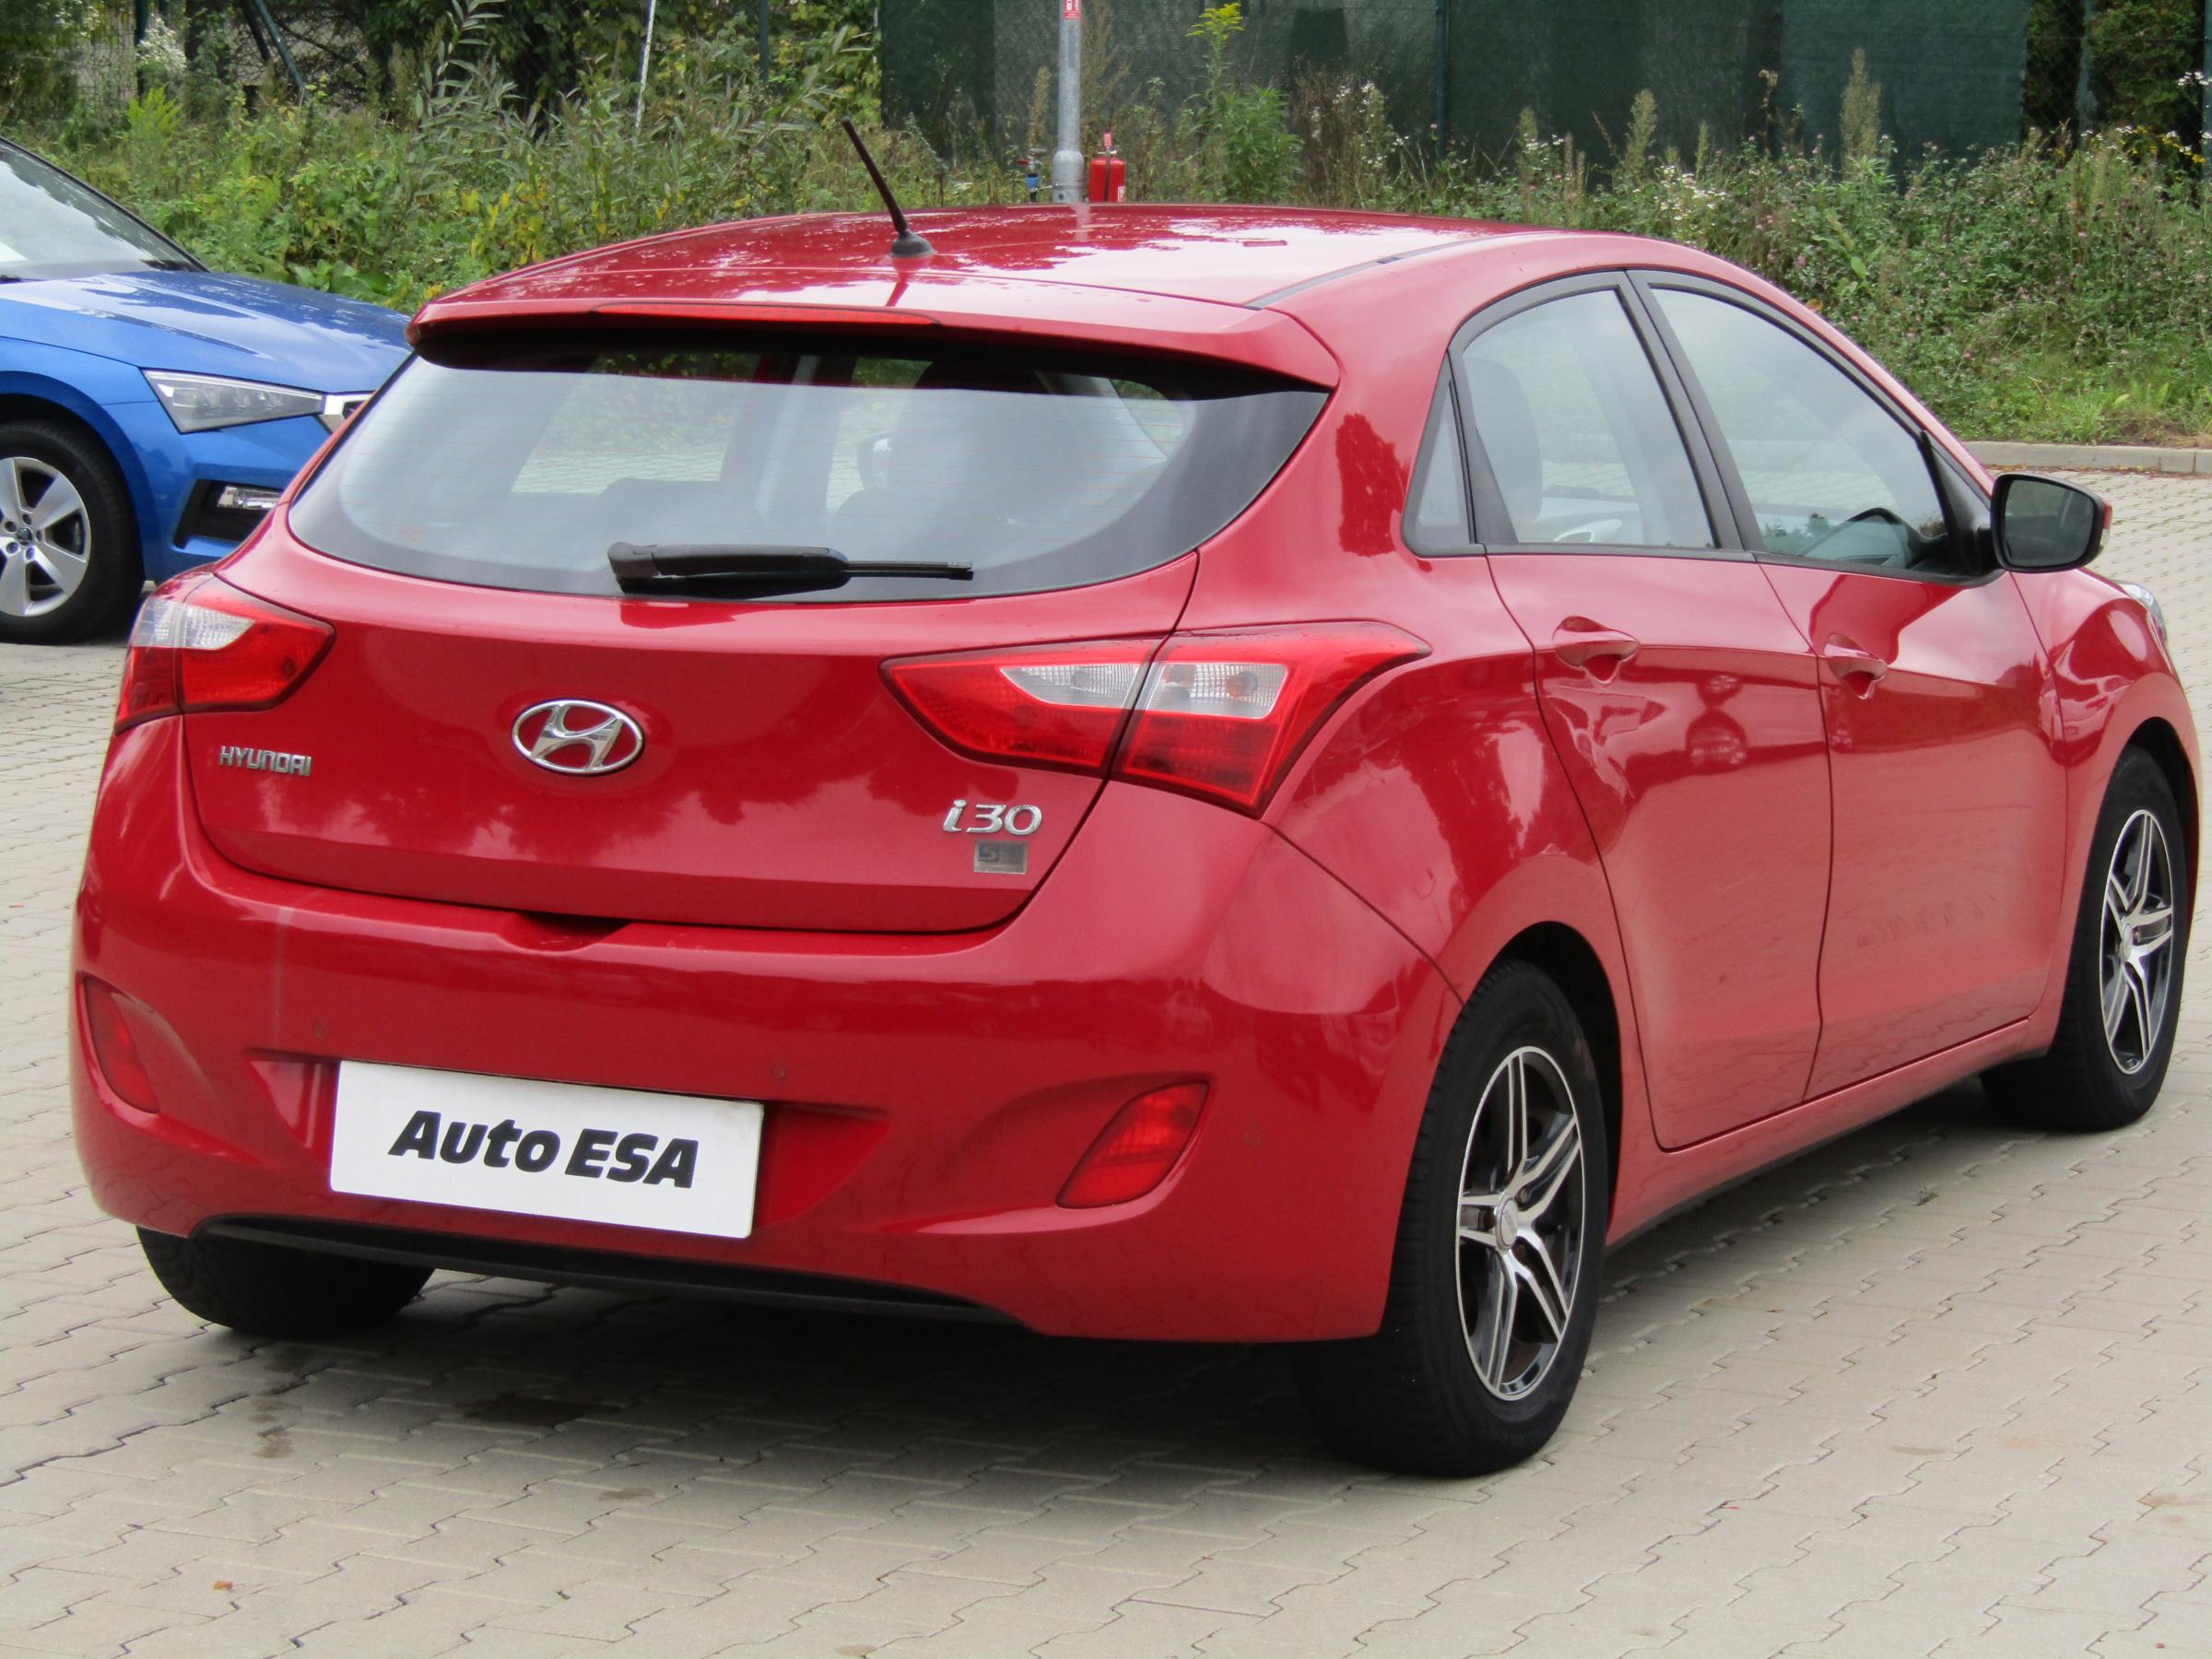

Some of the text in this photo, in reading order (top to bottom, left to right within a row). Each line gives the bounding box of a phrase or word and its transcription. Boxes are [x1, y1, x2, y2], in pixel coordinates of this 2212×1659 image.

[219, 745, 312, 776] HYUNDAI
[943, 798, 1042, 835] i30
[388, 1110, 700, 1189] Auto ESA
